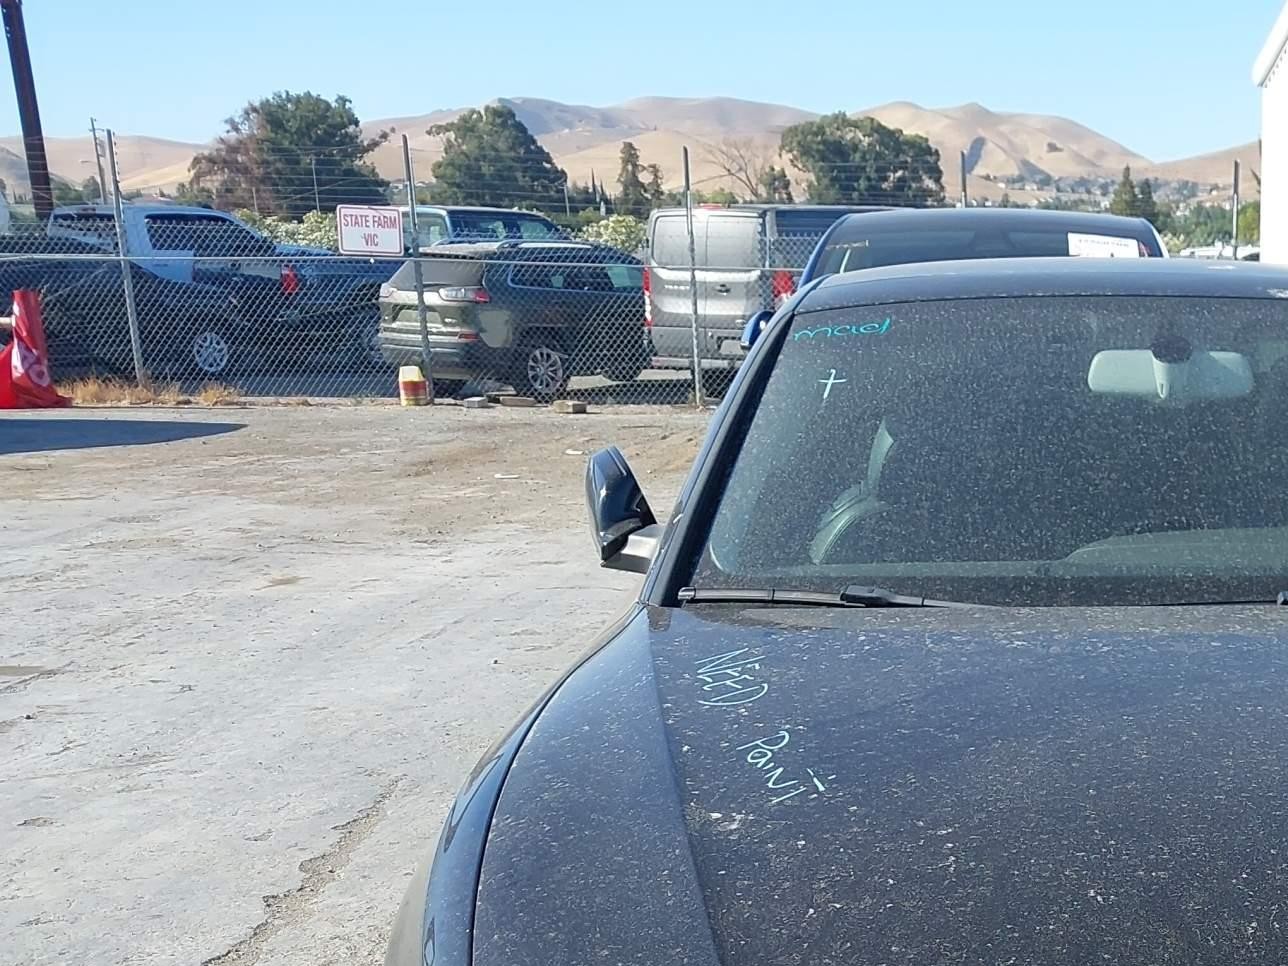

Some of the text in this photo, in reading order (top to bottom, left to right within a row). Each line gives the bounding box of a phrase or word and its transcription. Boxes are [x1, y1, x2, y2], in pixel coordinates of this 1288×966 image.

[343, 214, 397, 229] STATE FARM
[363, 233, 379, 247] VIC
